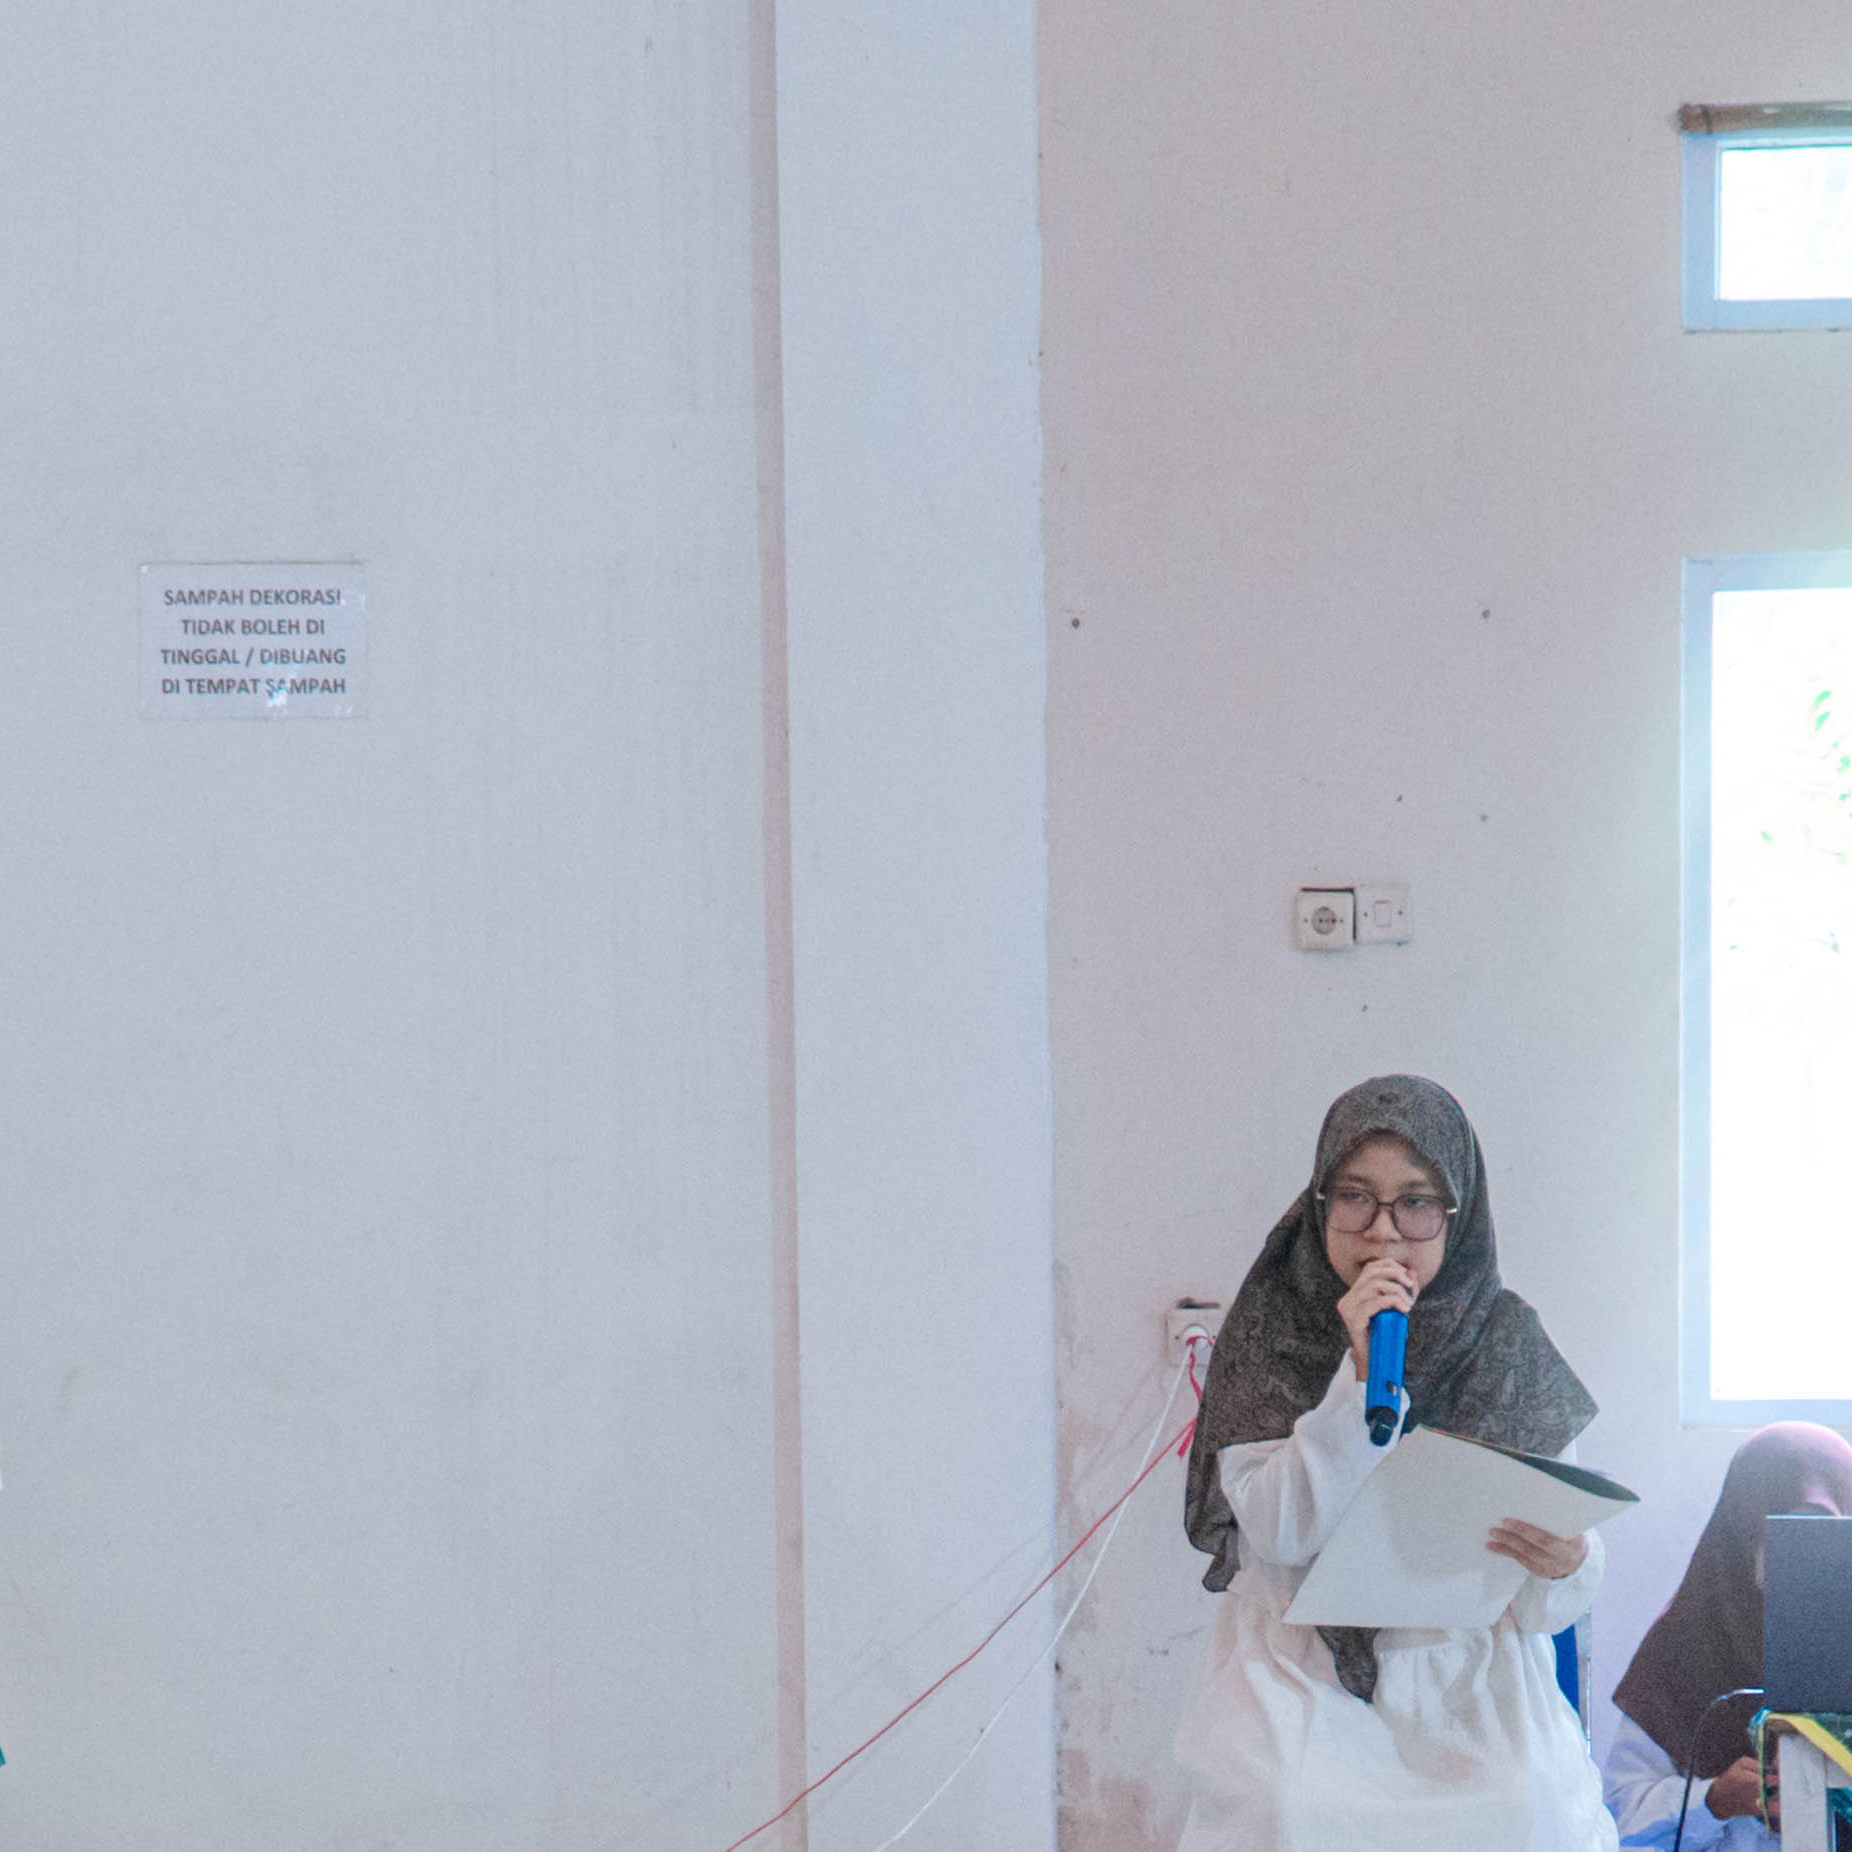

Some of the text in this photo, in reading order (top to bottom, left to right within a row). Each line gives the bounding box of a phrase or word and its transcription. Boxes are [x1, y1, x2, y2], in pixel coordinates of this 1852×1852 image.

[163, 588, 342, 606] SAMPAH DEKORASI
[181, 618, 326, 636] TIDAK BOLEH DI
[160, 647, 347, 668] TINGGAL / DIBUANG
[161, 678, 347, 695] DI TEMPAT SAMPAH
